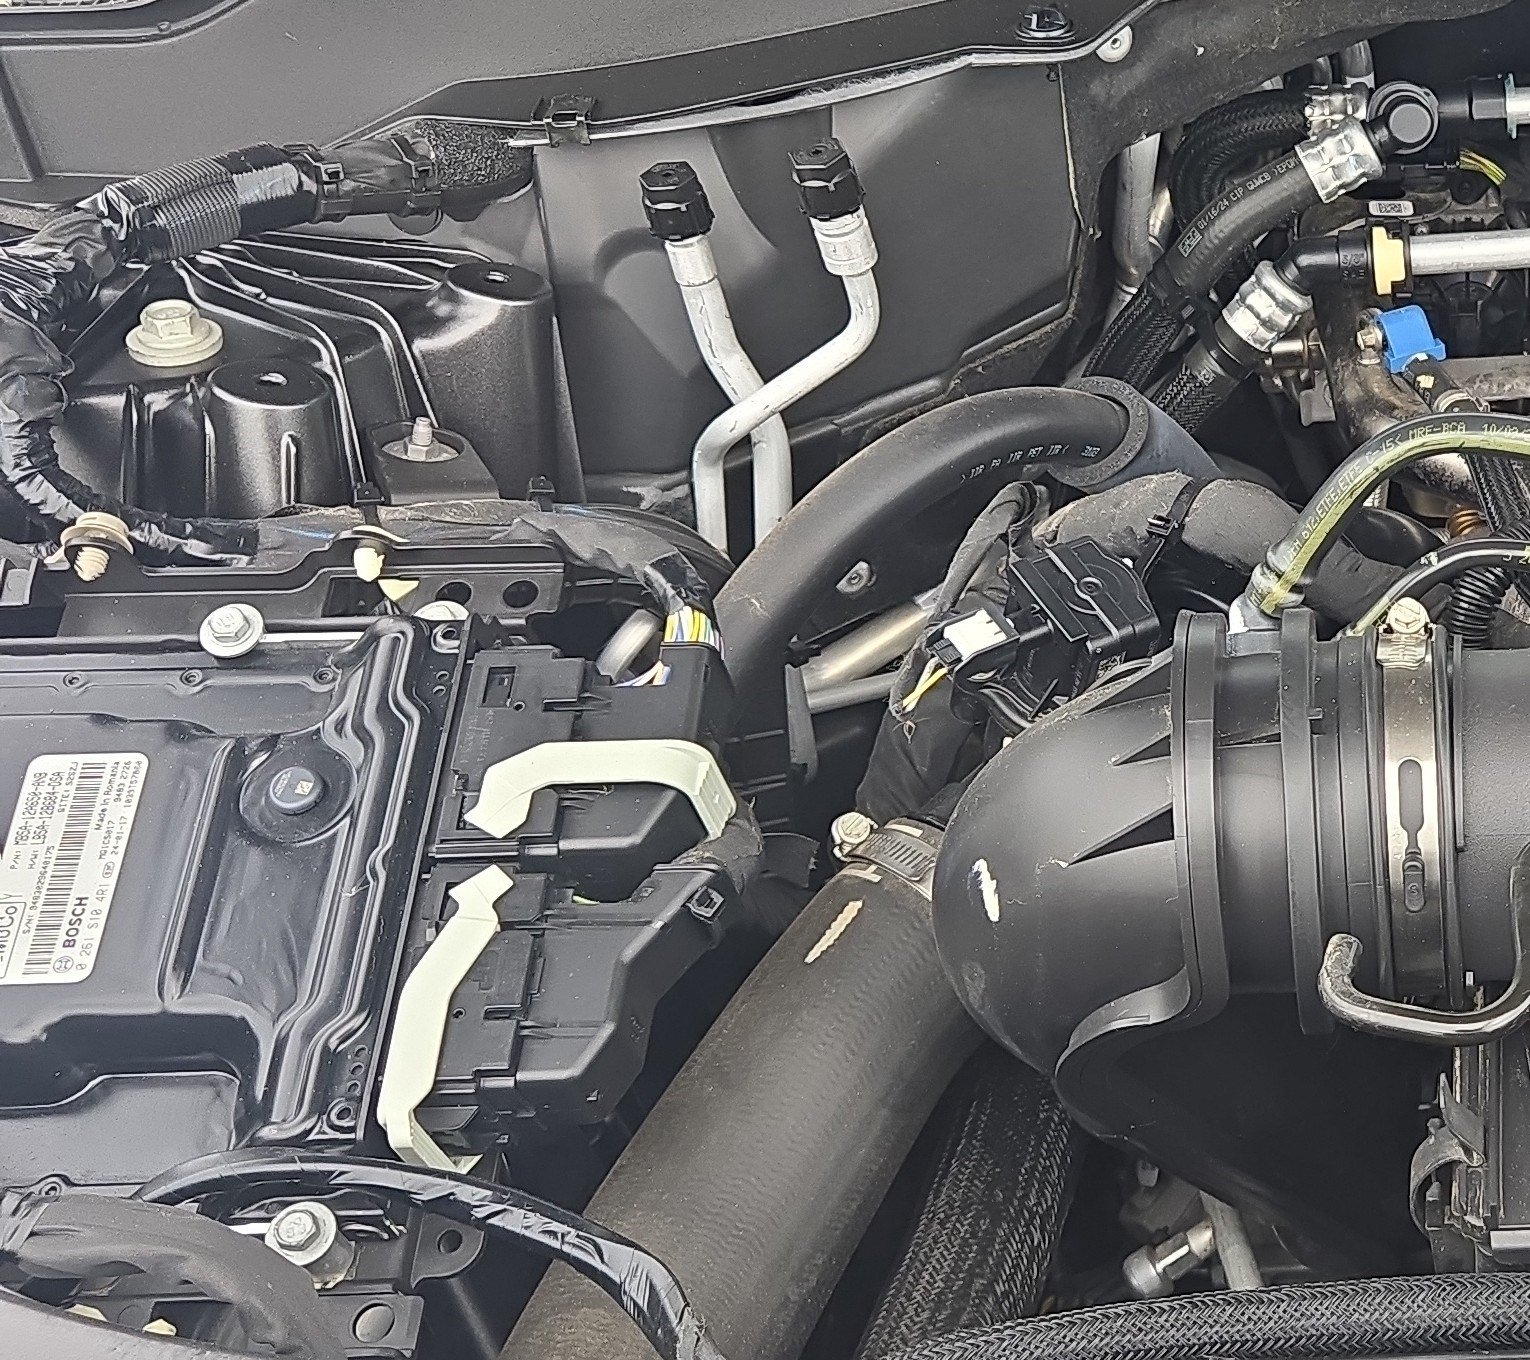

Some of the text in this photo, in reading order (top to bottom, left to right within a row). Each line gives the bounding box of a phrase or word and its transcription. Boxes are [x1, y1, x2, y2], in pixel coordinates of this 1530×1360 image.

[94, 808, 108, 831] Made
[104, 761, 120, 796] Romania
[62, 897, 89, 948] BOSCH
[80, 938, 95, 956] 261
